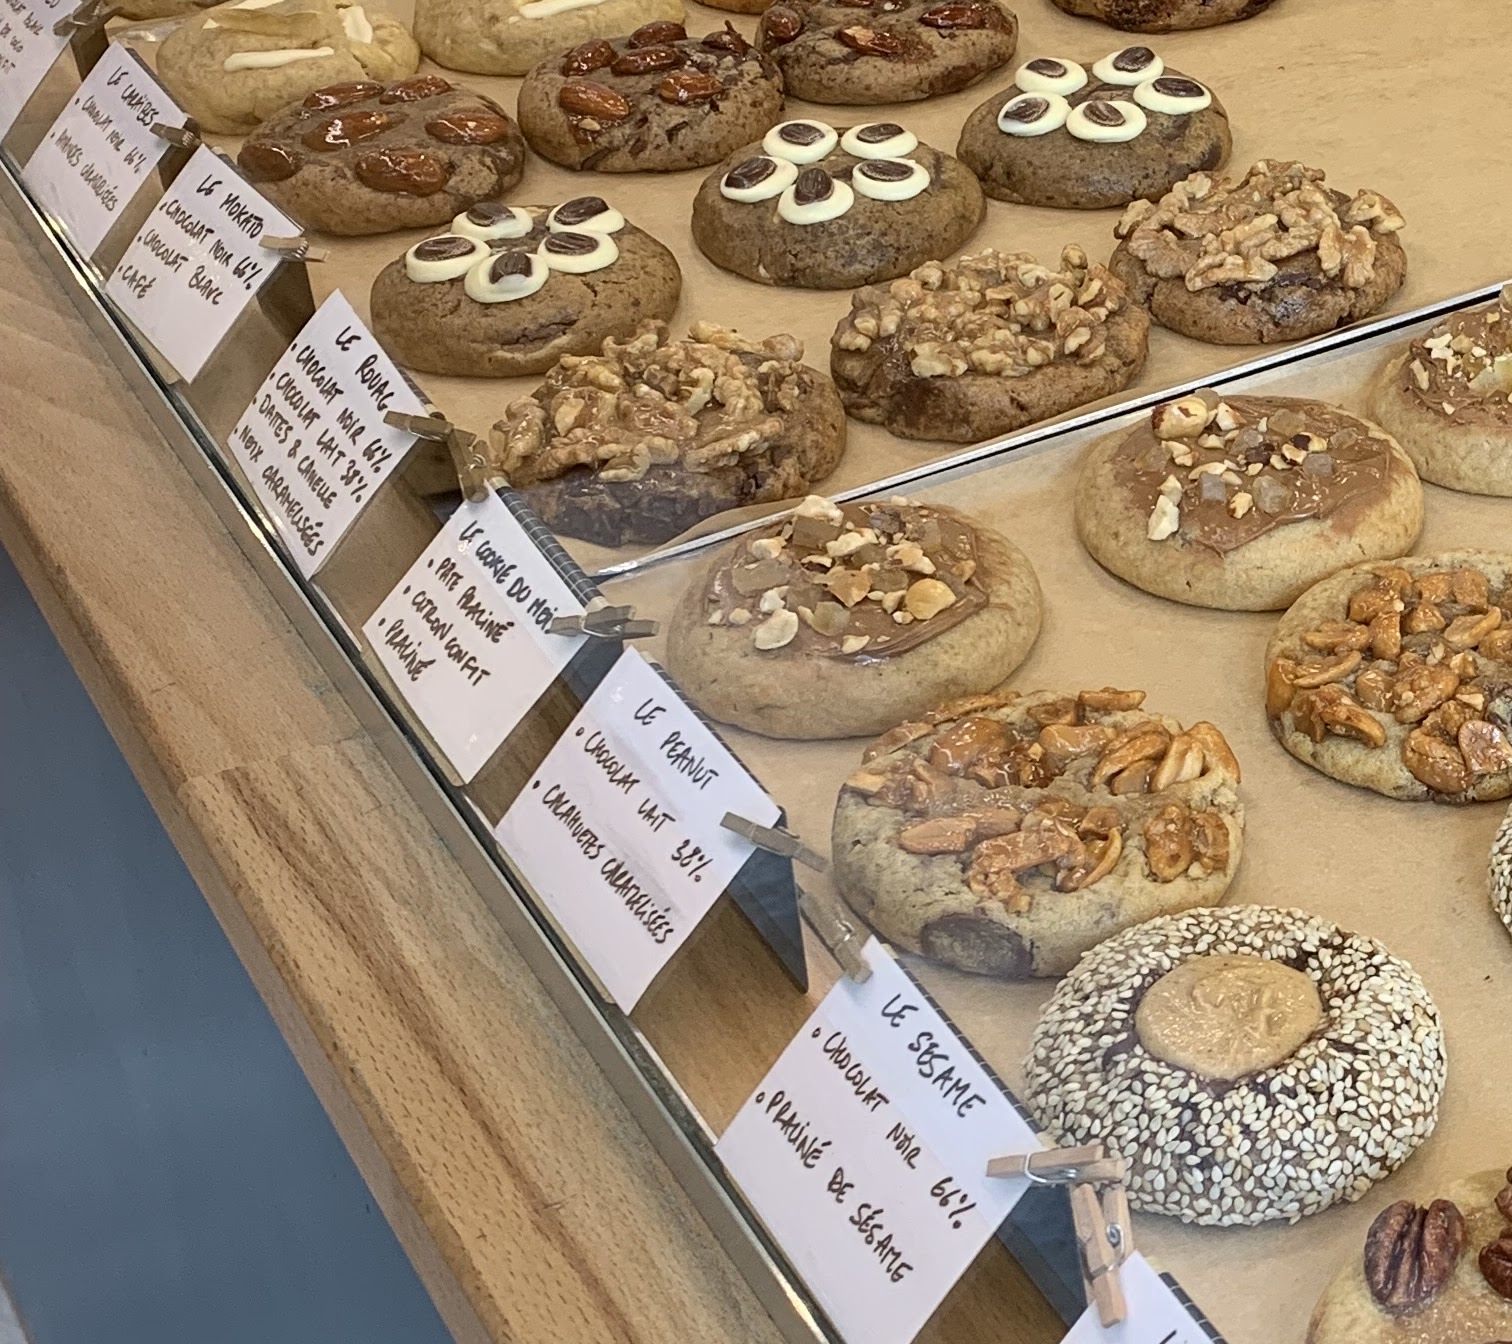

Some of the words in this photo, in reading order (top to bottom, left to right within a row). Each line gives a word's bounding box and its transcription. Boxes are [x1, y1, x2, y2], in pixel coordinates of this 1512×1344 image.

[107, 66, 129, 85] LE
[81, 95, 112, 132] CHOCOLAT
[106, 129, 125, 152] NOIR
[123, 146, 147, 174] 66%
[165, 199, 215, 244] CHOCOLAT
[209, 239, 233, 267] NOIR
[232, 256, 263, 290] 66%
[196, 174, 222, 196] LE
[219, 192, 264, 239] MOKATO
[122, 265, 156, 299] CAFÉ
[143, 229, 189, 273] CHOCOLAT
[188, 265, 223, 305] BLANC
[335, 325, 361, 352] LE
[258, 394, 294, 444] DATTES
[287, 439, 302, 459] &
[276, 372, 321, 431] CHOCOLAT
[316, 428, 346, 467] LAIT
[340, 459, 368, 503] 38%
[296, 344, 344, 405] CHOCOLAT
[336, 407, 366, 446] NOIR
[362, 438, 392, 473] 66%
[238, 424, 264, 463] NOIX
[262, 465, 325, 556] CARAMELISÉES
[437, 557, 463, 591] PÂTE
[457, 585, 514, 644] PRALINÉ
[459, 520, 484, 541] LE
[476, 540, 517, 584] COOKIE
[507, 577, 531, 603] DU
[527, 597, 558, 634] MOI
[385, 618, 436, 681] PRALINÉ
[412, 590, 454, 641] CITRON
[444, 637, 490, 686] CONFIT
[633, 698, 666, 726] LE
[660, 730, 719, 790] PEANUT
[584, 731, 640, 795] CHOCOLAT
[637, 798, 676, 833] LAIT
[671, 839, 714, 883] 38%
[601, 857, 675, 944] CARAMELISÉES
[880, 993, 918, 1028] LE
[908, 1032, 987, 1118] SESAME
[823, 1031, 890, 1113] CHOCOLAT
[885, 1122, 921, 1170] NOIR
[930, 1176, 977, 1229] 66%
[763, 1090, 833, 1170] PRALINÉ
[828, 1166, 855, 1204] DE
[849, 1202, 914, 1283] SÉSAME
